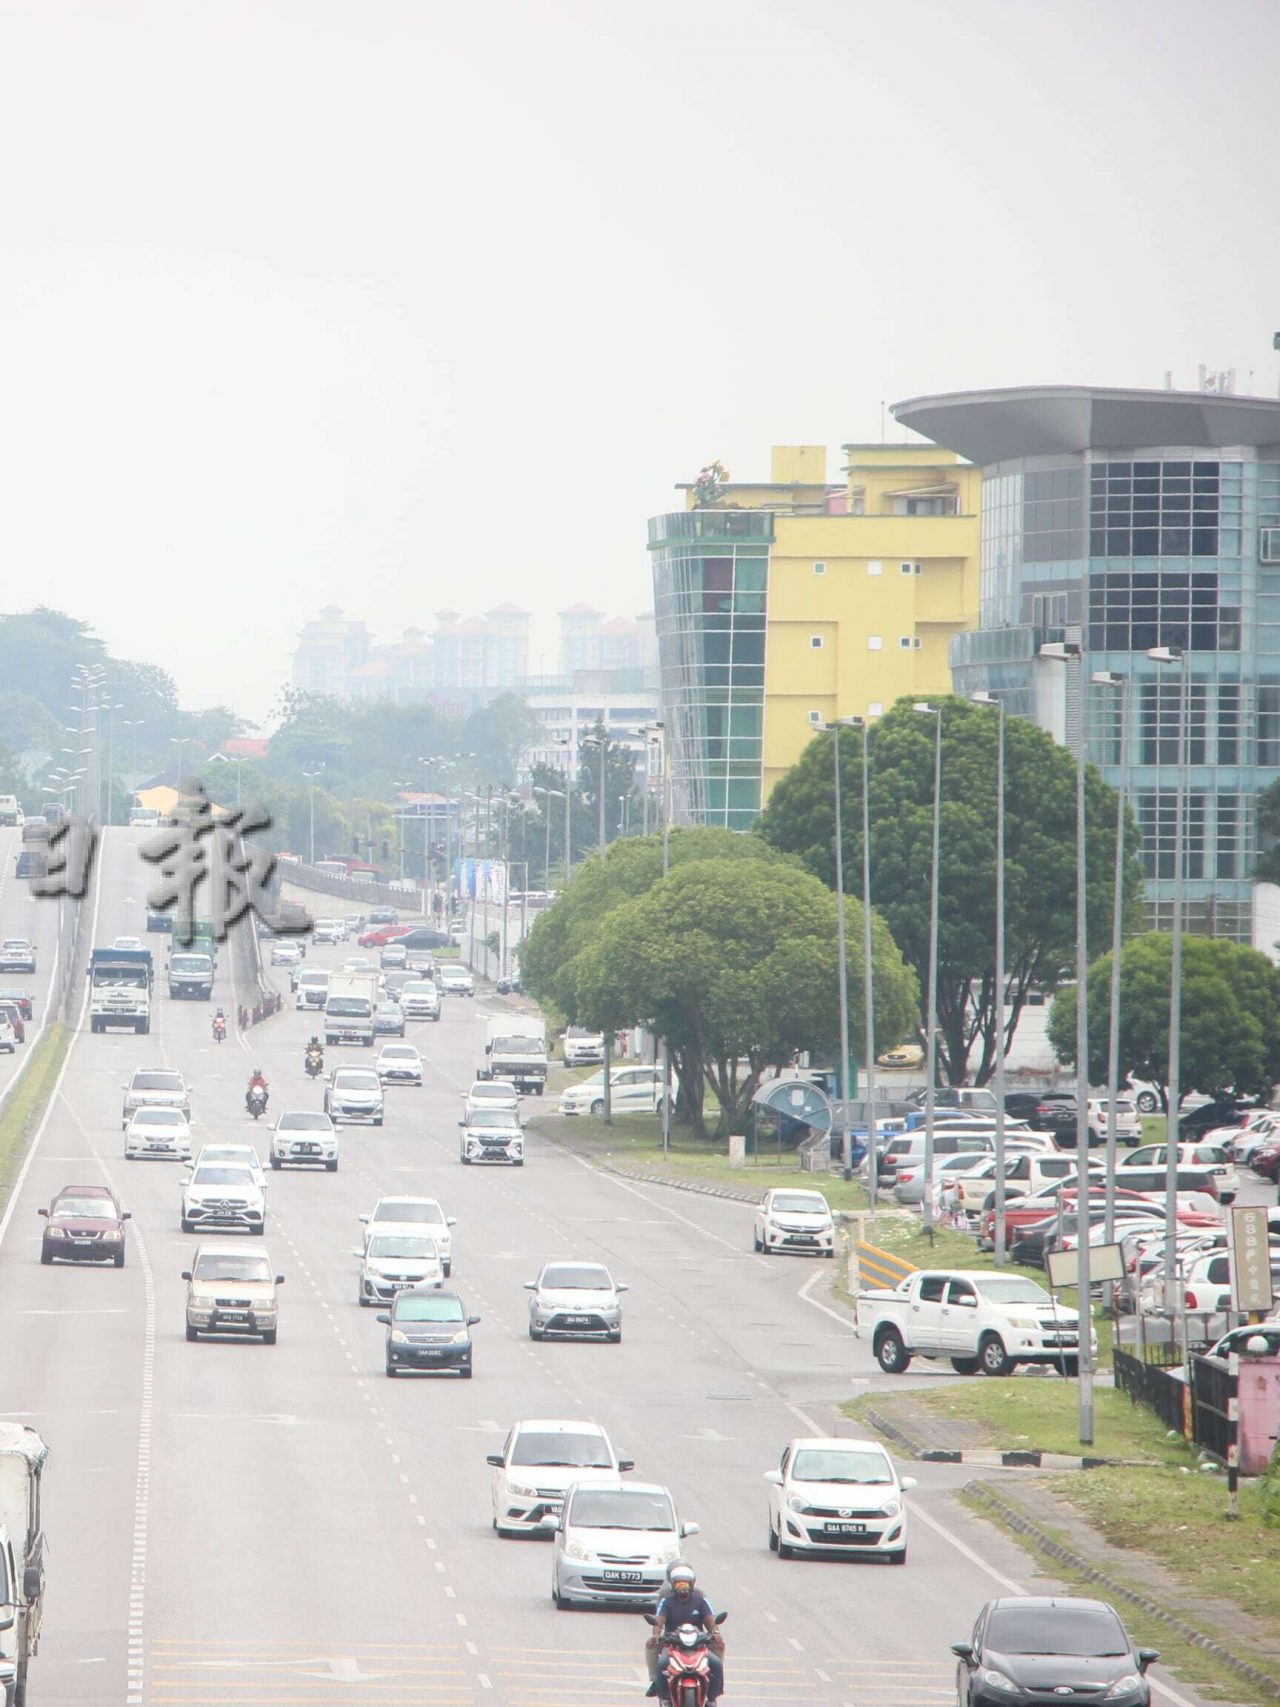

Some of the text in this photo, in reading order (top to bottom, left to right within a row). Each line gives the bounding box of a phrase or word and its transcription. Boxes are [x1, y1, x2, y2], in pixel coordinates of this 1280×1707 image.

[827, 1524, 840, 1532] QAA
[605, 1571, 641, 1580] QAK 5773
